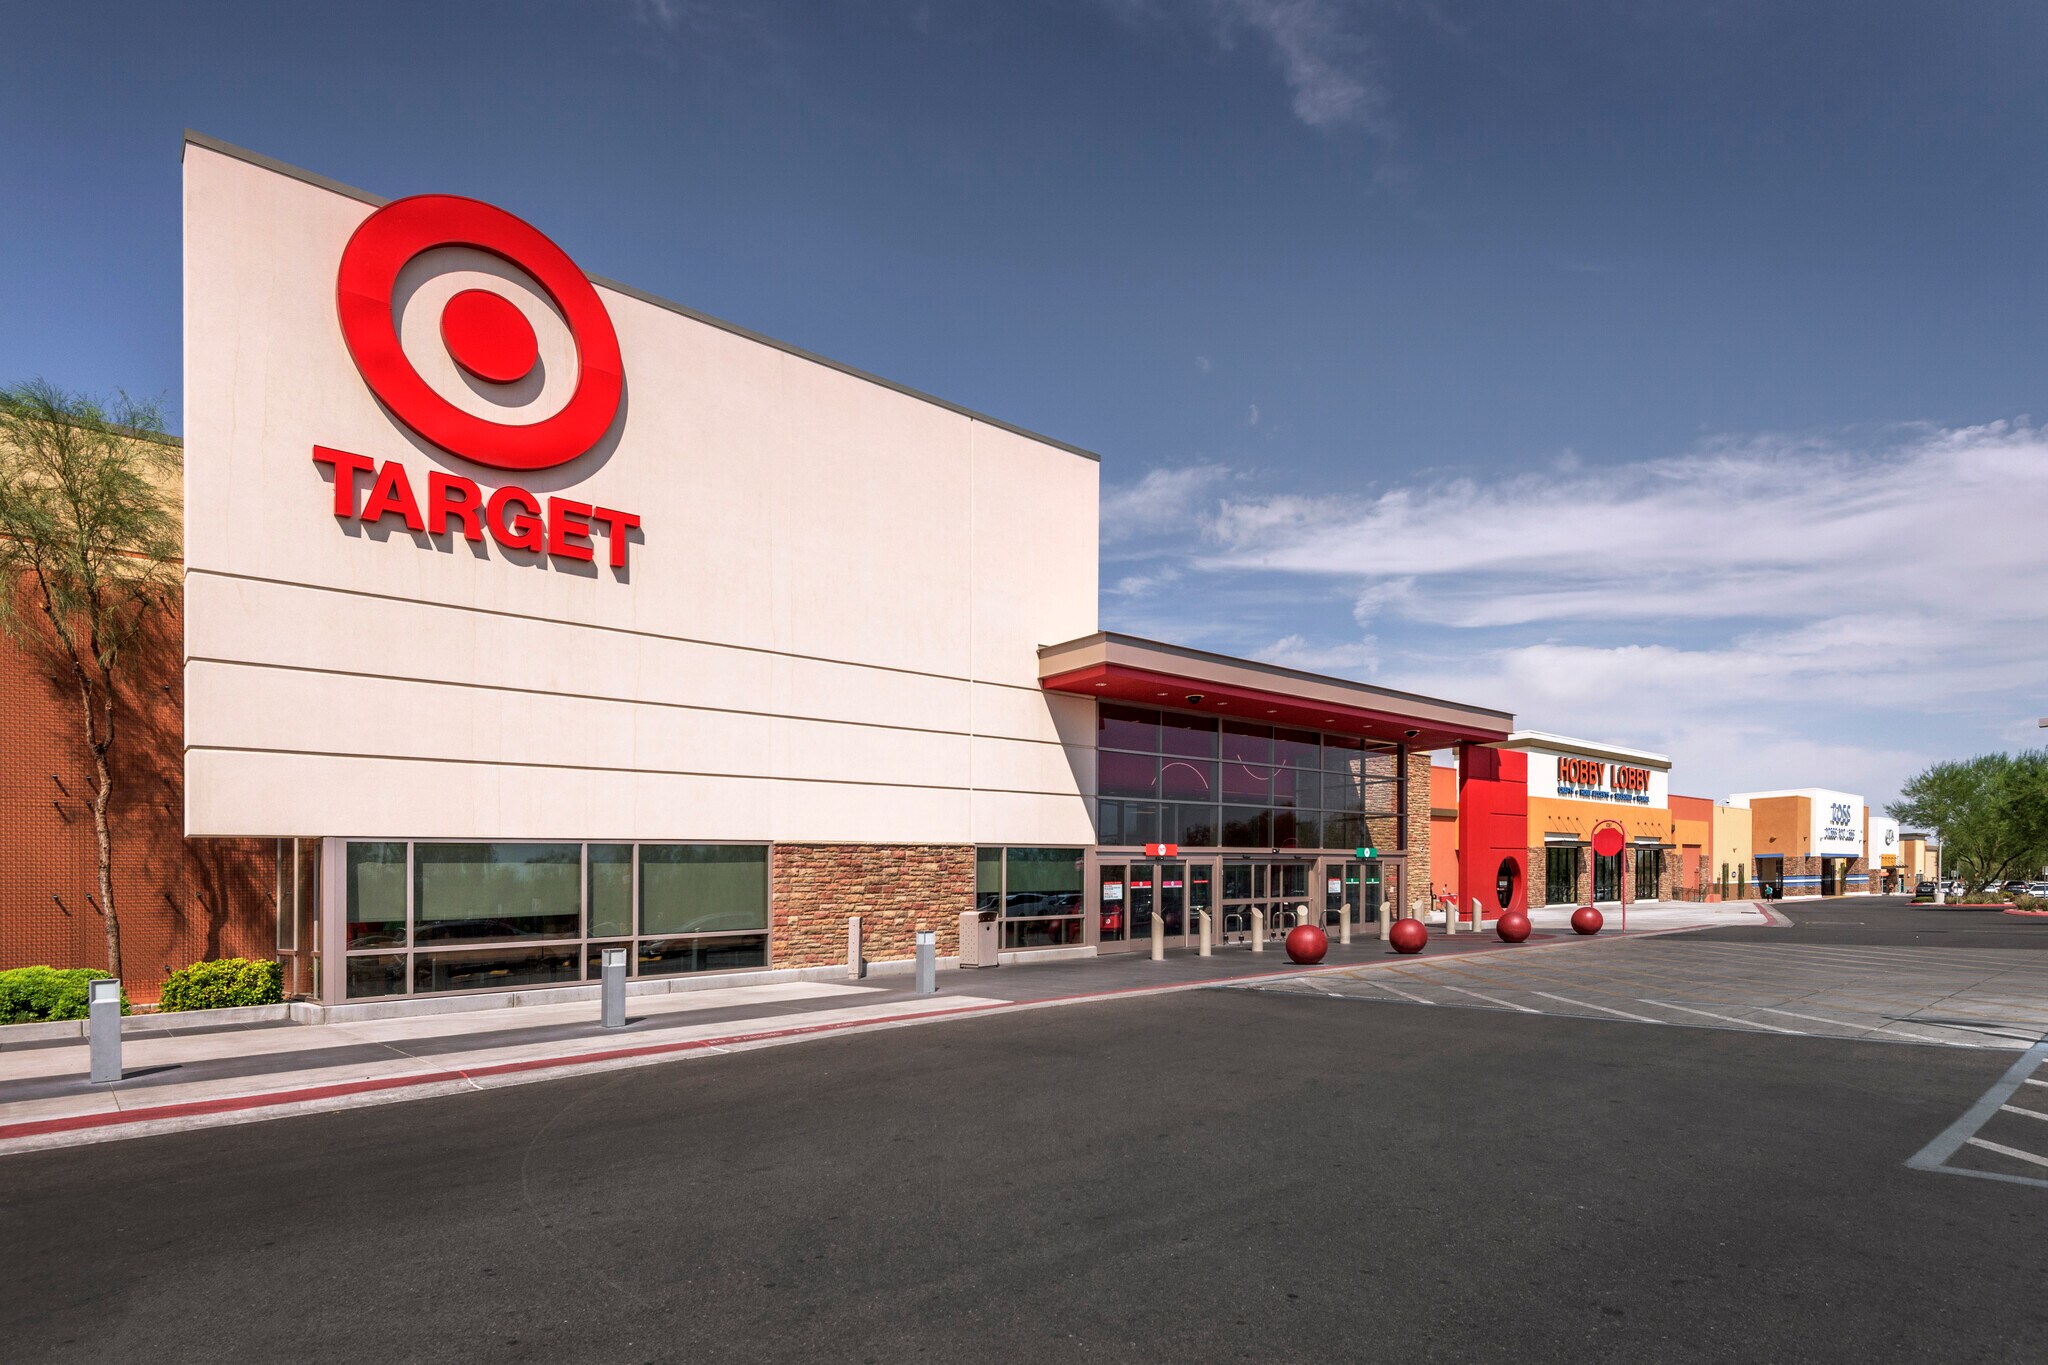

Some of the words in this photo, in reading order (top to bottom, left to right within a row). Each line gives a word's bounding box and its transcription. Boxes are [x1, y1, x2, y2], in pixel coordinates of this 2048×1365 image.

[313, 445, 641, 567] TARGET
[1558, 757, 1606, 786] HOBBY
[1610, 764, 1651, 791] LOBBY
